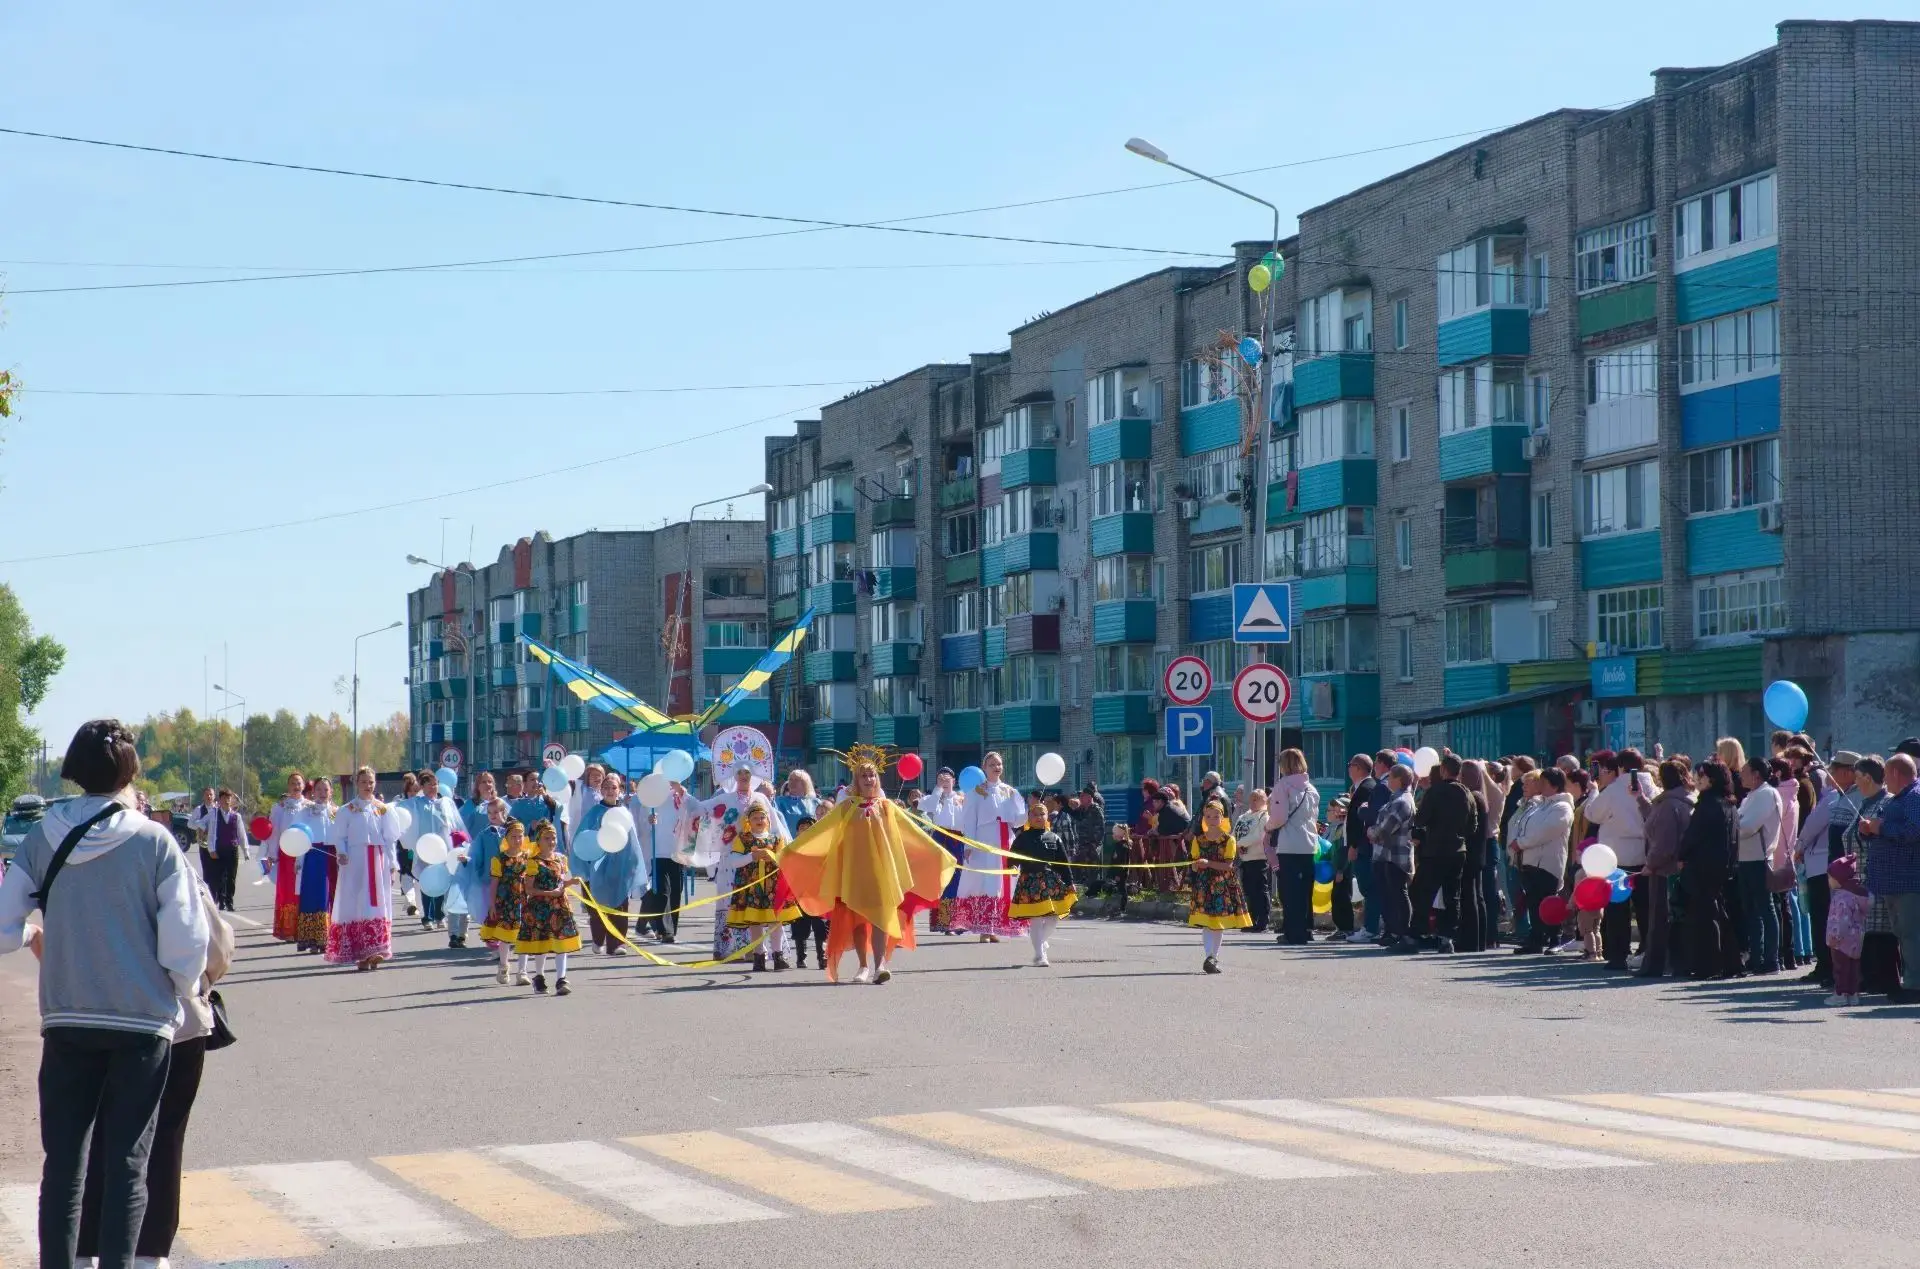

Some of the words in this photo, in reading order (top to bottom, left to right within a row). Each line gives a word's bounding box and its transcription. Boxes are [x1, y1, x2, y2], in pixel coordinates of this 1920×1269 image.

[1176, 672, 1202, 690] 20
[1248, 681, 1279, 703] 20
[1178, 712, 1204, 750] P
[444, 753, 459, 762] 40
[546, 750, 562, 761] 40
